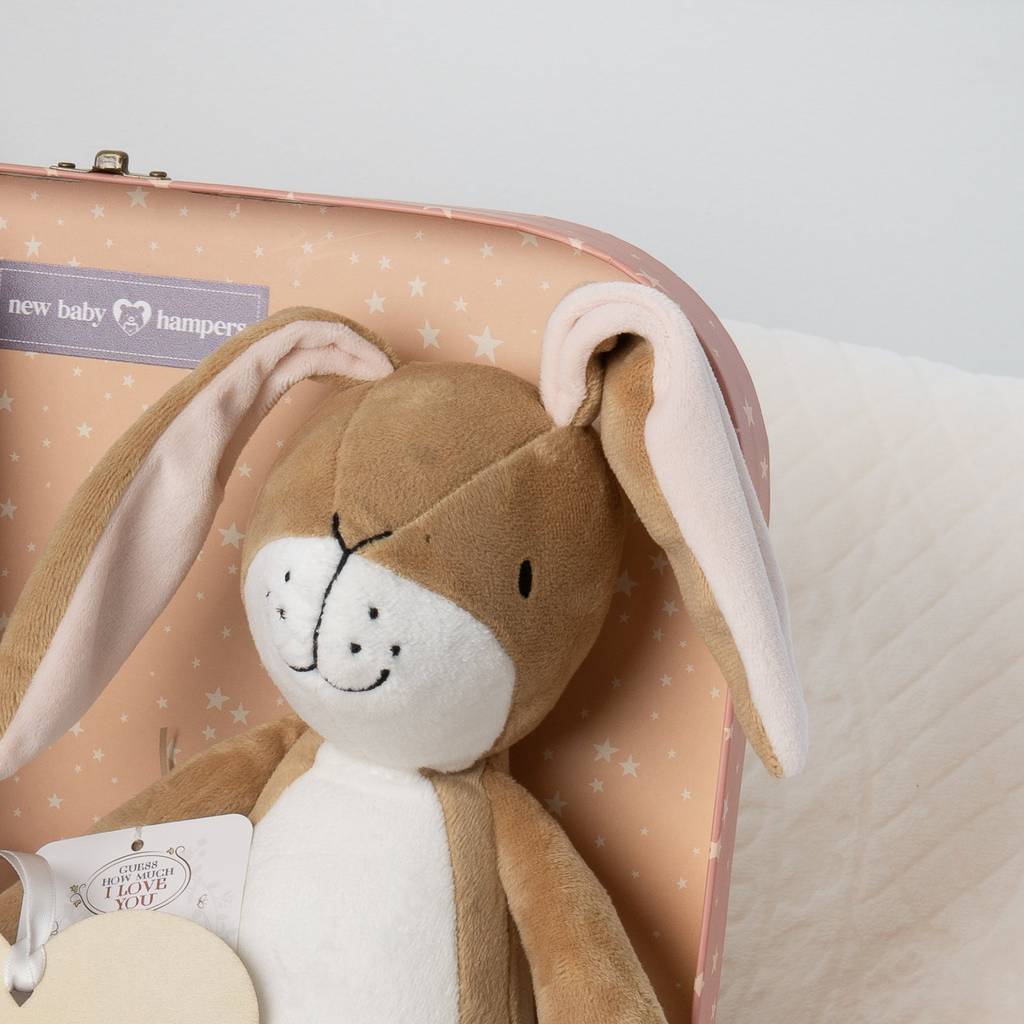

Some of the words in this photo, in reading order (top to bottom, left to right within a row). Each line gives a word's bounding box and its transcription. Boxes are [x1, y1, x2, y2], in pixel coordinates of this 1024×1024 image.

[8, 298, 51, 317] new
[57, 300, 107, 328] baby
[119, 861, 158, 874] GUESS
[102, 874, 131, 886] HOW
[136, 868, 174, 880] MUCH
[105, 886, 112, 899] I
[118, 878, 167, 897] LOVE
[115, 893, 155, 911] YOU
